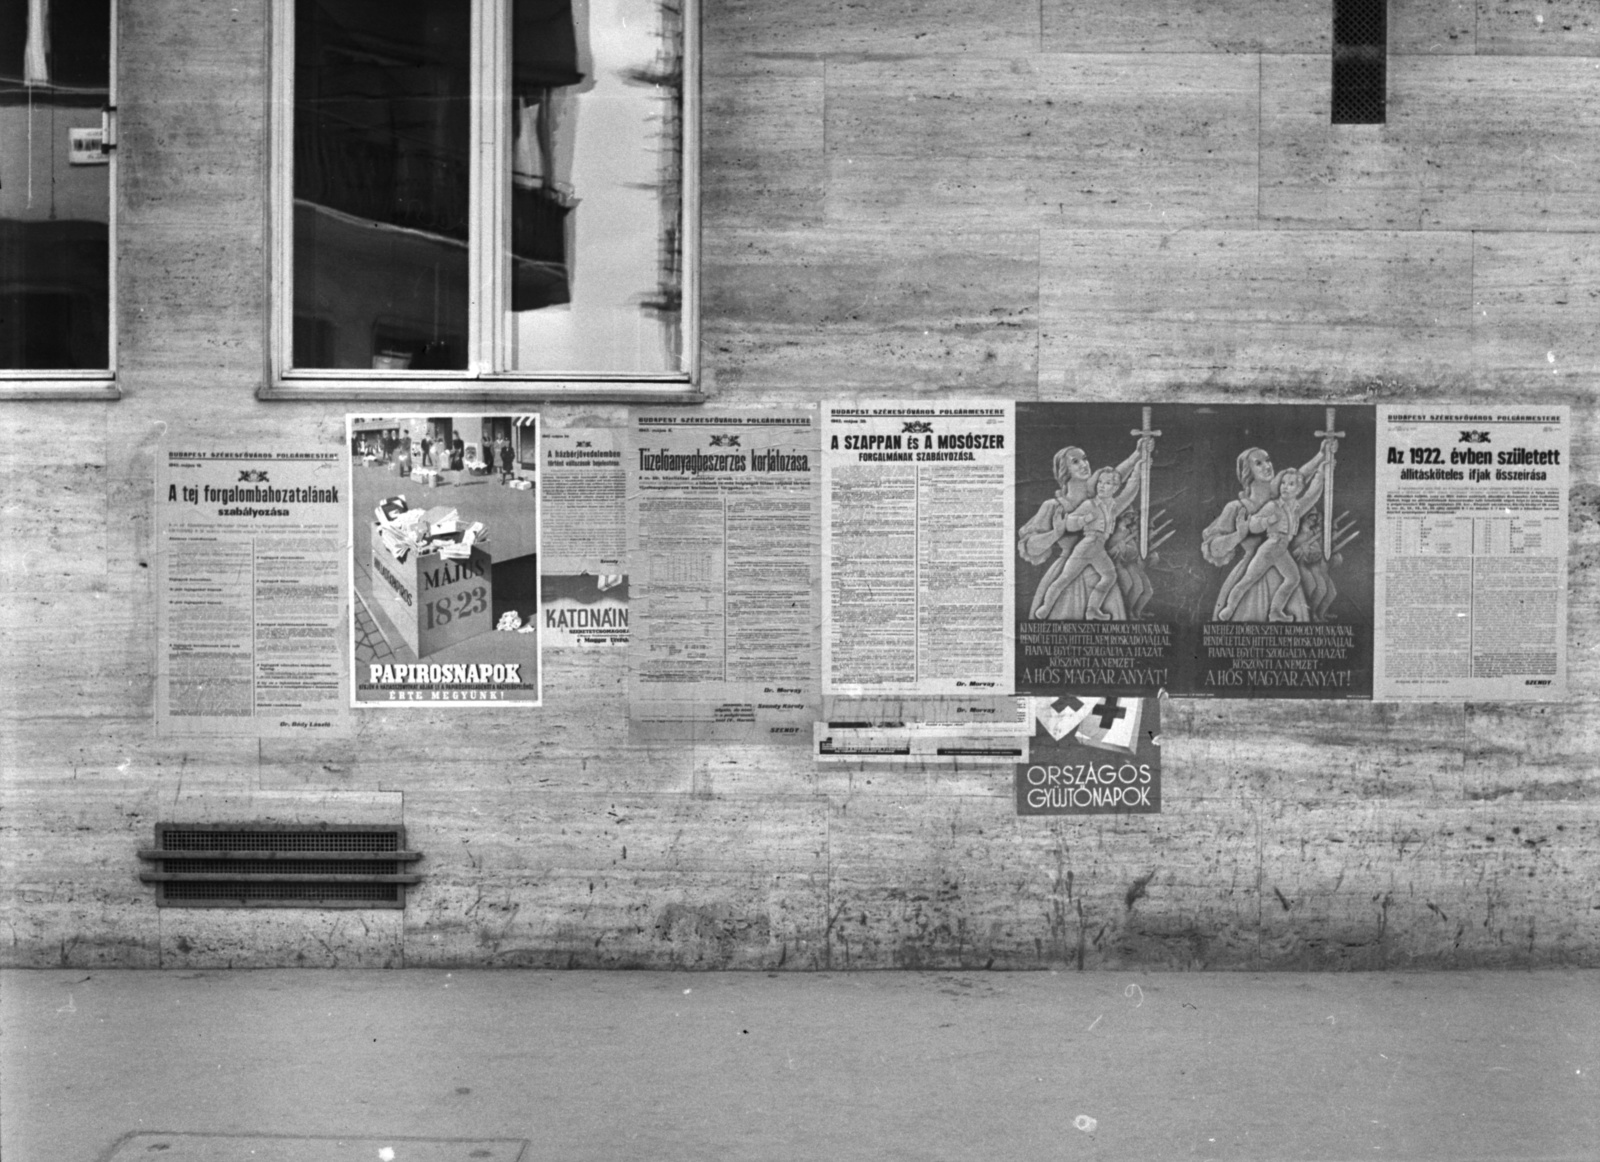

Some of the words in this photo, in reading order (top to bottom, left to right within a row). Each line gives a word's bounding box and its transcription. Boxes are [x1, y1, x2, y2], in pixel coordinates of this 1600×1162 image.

[831, 434, 839, 450] A
[844, 434, 902, 450] SZAPPAN
[907, 436, 919, 449] ÉS
[924, 434, 933, 449] A
[938, 432, 1004, 449] MOSÓSZER
[751, 448, 811, 472] korlátozása.
[859, 451, 913, 462] FORGALMÁNAK
[916, 451, 976, 462] SZABÁLYOZÁSA.
[1387, 447, 1404, 464] Az
[1410, 447, 1445, 464] 1922.
[1450, 447, 1492, 464] évben
[1497, 448, 1560, 465] született
[1468, 469, 1490, 483] ifjak
[169, 484, 177, 501] A
[183, 485, 198, 505] tej
[204, 485, 338, 505] forgalombahozatalának
[218, 507, 289, 518] szabályozása
[424, 559, 484, 590] MÁJUS
[426, 586, 487, 630] 18-23
[546, 608, 629, 628] KATONÁIN
[1126, 647, 1132, 657] A
[1309, 648, 1316, 658] A
[1050, 657, 1090, 667] KÖSZÖNTI
[1093, 658, 1099, 667] A
[1101, 658, 1135, 668] NEMZET
[1232, 658, 1272, 669] KÖSZÖNTI
[1275, 660, 1282, 669] A
[1284, 659, 1318, 669] NEMZET
[370, 664, 522, 683] PAPIROSNAPOK
[1022, 667, 1031, 684] A
[1034, 667, 1060, 684] HŐS
[1065, 669, 1115, 684] MAGYAR
[1117, 668, 1168, 684] ANYÁT!
[1205, 670, 1216, 685] A
[1218, 669, 1243, 685] HŐS
[1248, 670, 1298, 686] MAGYAR
[1300, 670, 1350, 686] ANYÁT!
[389, 690, 423, 700] ÉRTE
[431, 690, 504, 700] MEGYÜNK!
[1027, 761, 1151, 785] ORSZÁGOS
[1027, 785, 1151, 808] GYÜJTŐNAPOK
